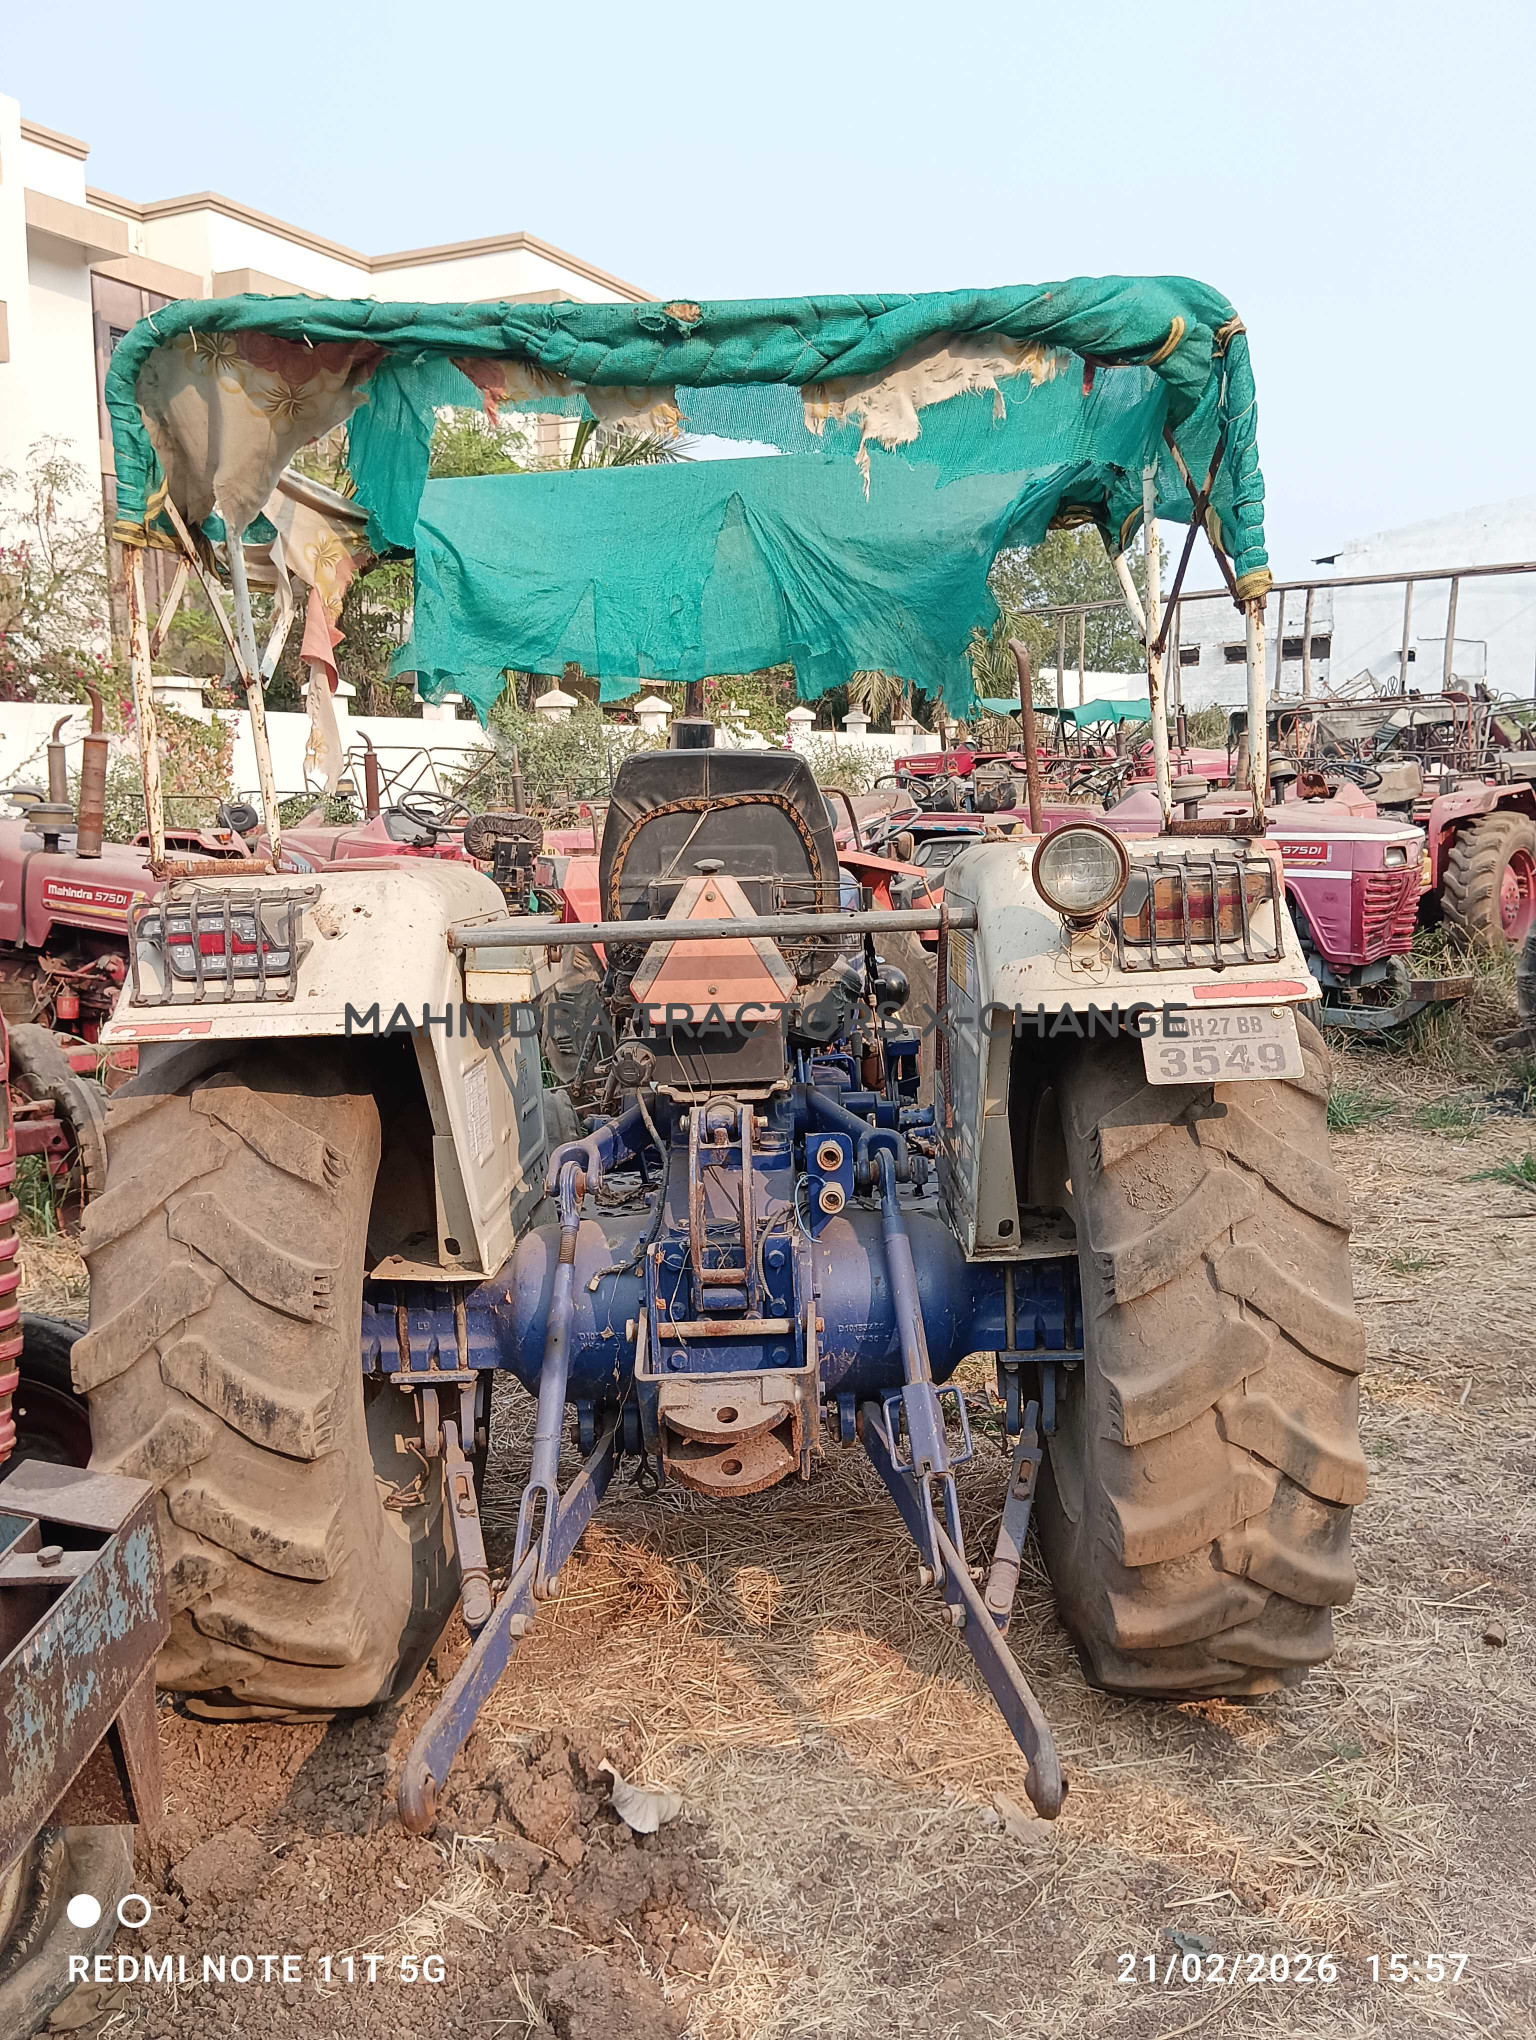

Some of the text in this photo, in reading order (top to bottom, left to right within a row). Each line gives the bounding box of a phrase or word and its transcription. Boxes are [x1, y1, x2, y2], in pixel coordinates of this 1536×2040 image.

[1282, 846, 1322, 855] 575DI
[48, 884, 127, 904] Mahindra 575DI
[1207, 1017, 1230, 1035] 27
[1236, 1016, 1263, 1034] BB
[1160, 1043, 1286, 1077] 3549
